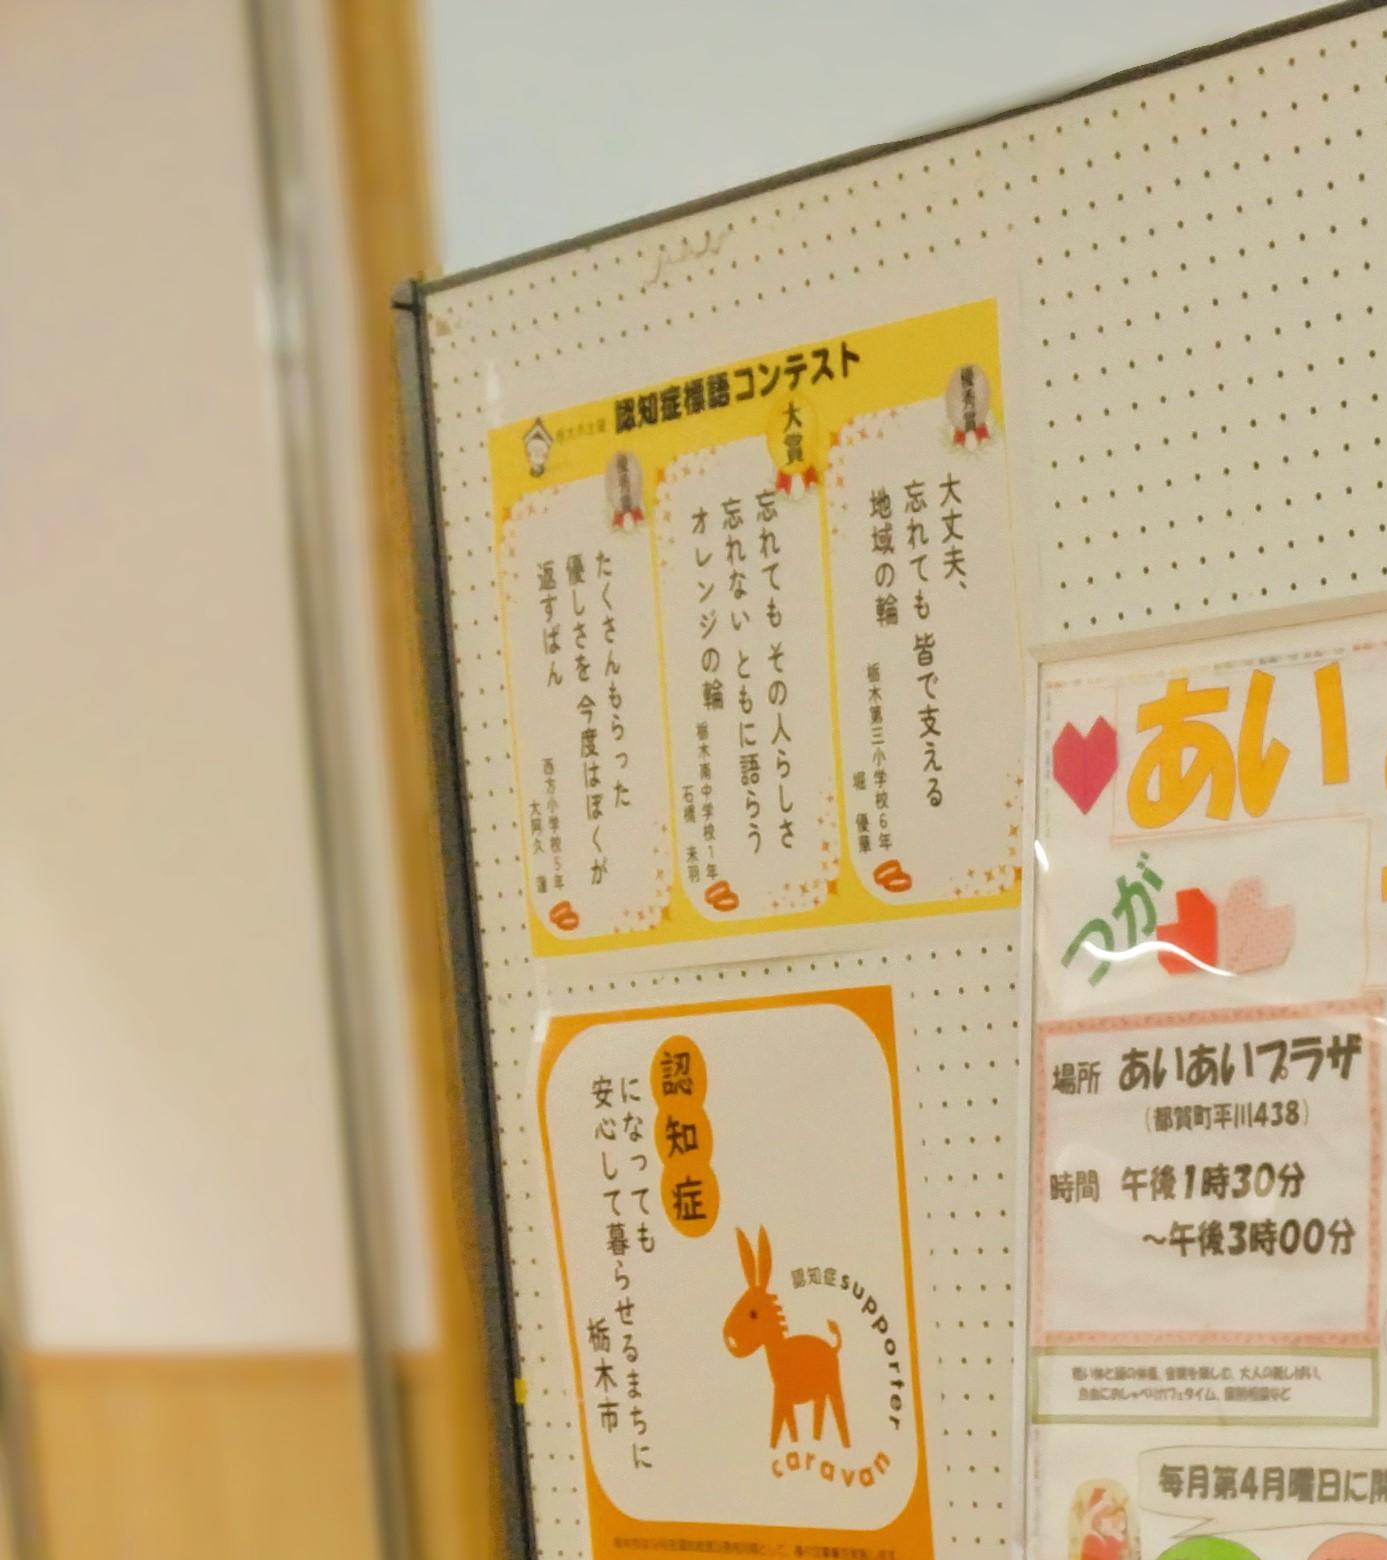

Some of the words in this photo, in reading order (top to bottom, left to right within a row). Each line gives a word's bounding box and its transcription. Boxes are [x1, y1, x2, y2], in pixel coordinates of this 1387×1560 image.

[614, 341, 861, 434] 認知症標語コンテスト
[782, 401, 805, 467] 大賞
[691, 507, 725, 712] オレンジの輪
[868, 489, 900, 627] 地域の輪
[594, 551, 631, 808] たくさんもらった
[1061, 851, 1166, 987] つが
[1052, 1061, 1101, 1096] 場所
[1118, 1033, 1363, 1092] あいあいプラザ
[620, 1077, 656, 1255] になっても
[658, 1052, 707, 1223] 認知症
[1049, 1169, 1100, 1204] 時間
[1120, 1161, 1306, 1203] 午後1時30分
[591, 1075, 654, 1471] 安心して暮らせるまちに
[586, 1317, 621, 1434] 栃木市
[771, 1450, 892, 1489] caravan
